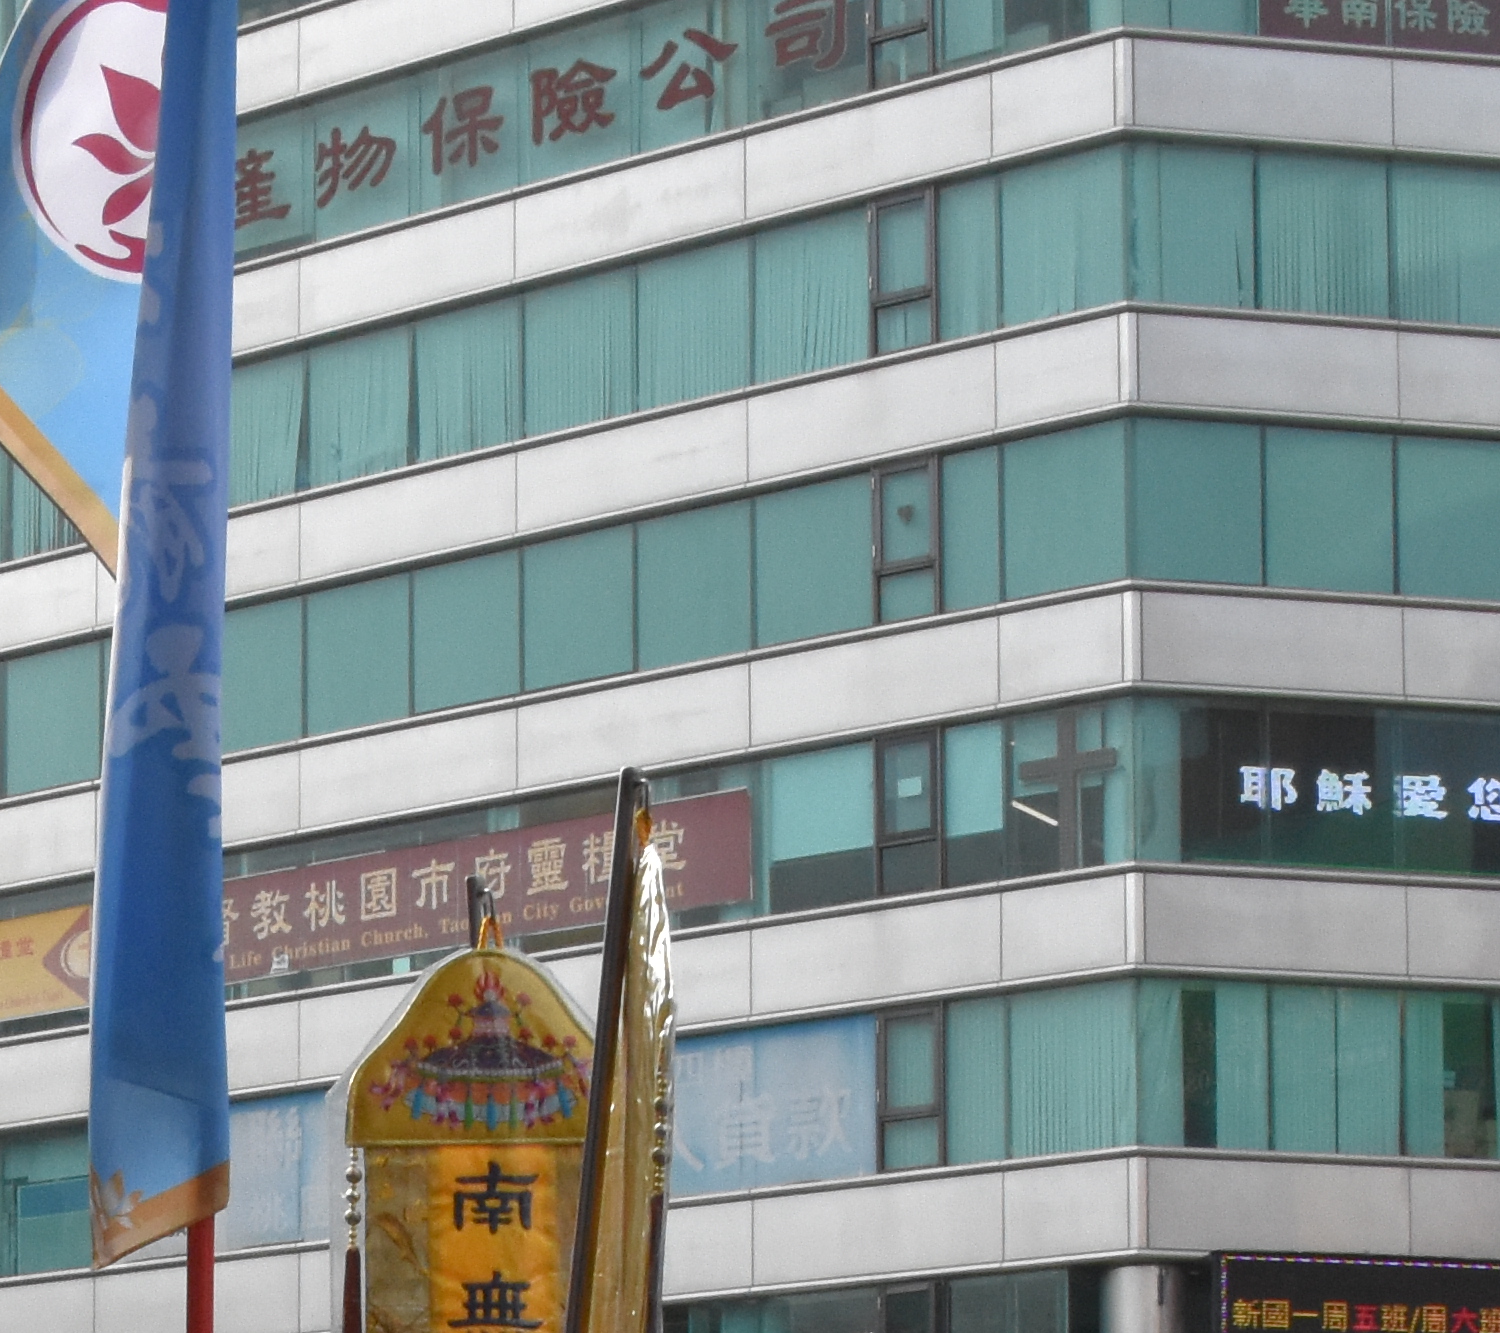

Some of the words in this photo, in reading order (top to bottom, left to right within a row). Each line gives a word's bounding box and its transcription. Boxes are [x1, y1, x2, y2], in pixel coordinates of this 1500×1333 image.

[228, 948, 263, 971] Life
[270, 936, 352, 966] Christian
[522, 899, 560, 924] City
